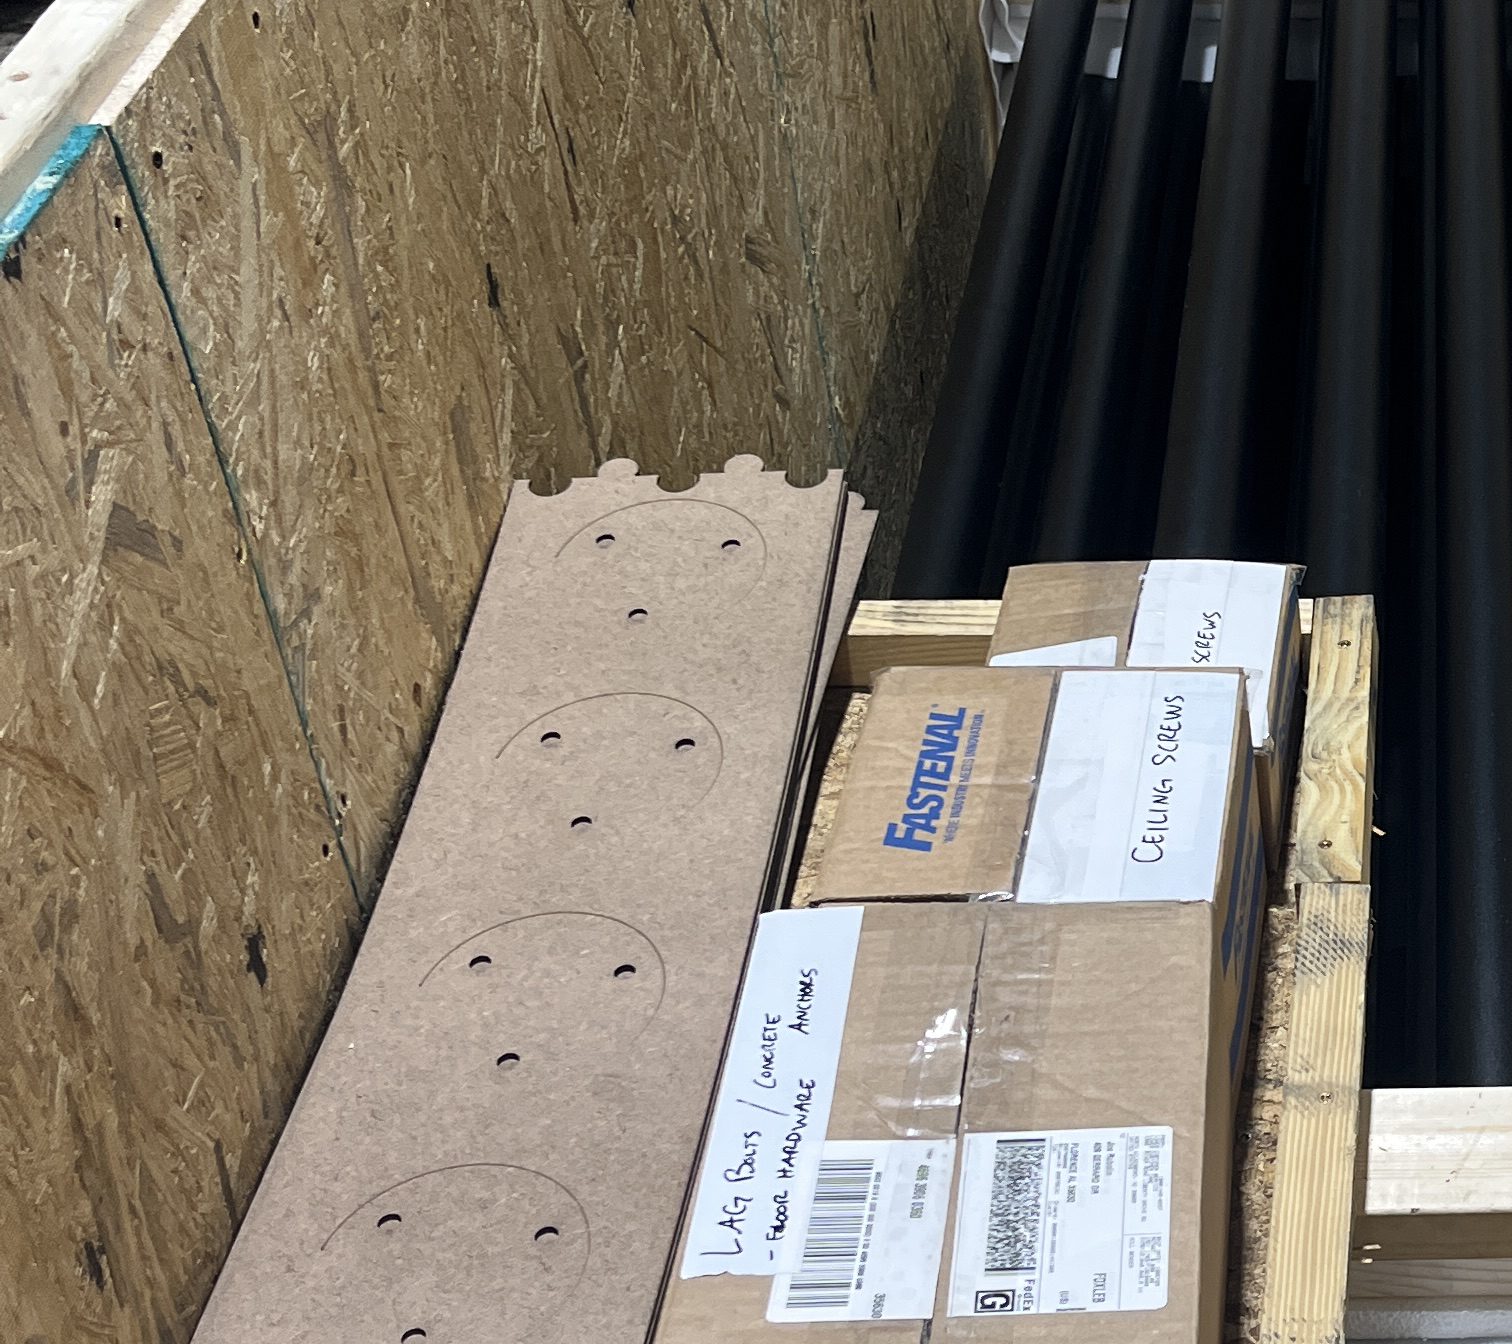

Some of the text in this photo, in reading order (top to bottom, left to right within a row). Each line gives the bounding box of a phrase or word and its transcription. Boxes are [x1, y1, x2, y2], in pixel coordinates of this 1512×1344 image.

[1191, 611, 1221, 664] SCREWS
[883, 707, 967, 852] FASTENAL
[1131, 695, 1185, 863] CEILING SCREWS
[788, 968, 819, 1035] ANCHORS
[753, 1012, 782, 1089] CONCRETE
[724, 1130, 762, 1183] BOLTS
[777, 1078, 816, 1180] HARDWARE
[700, 1196, 752, 1256] LAG
[979, 1293, 1011, 1310] G
[1022, 1278, 1036, 1311] FedEx
